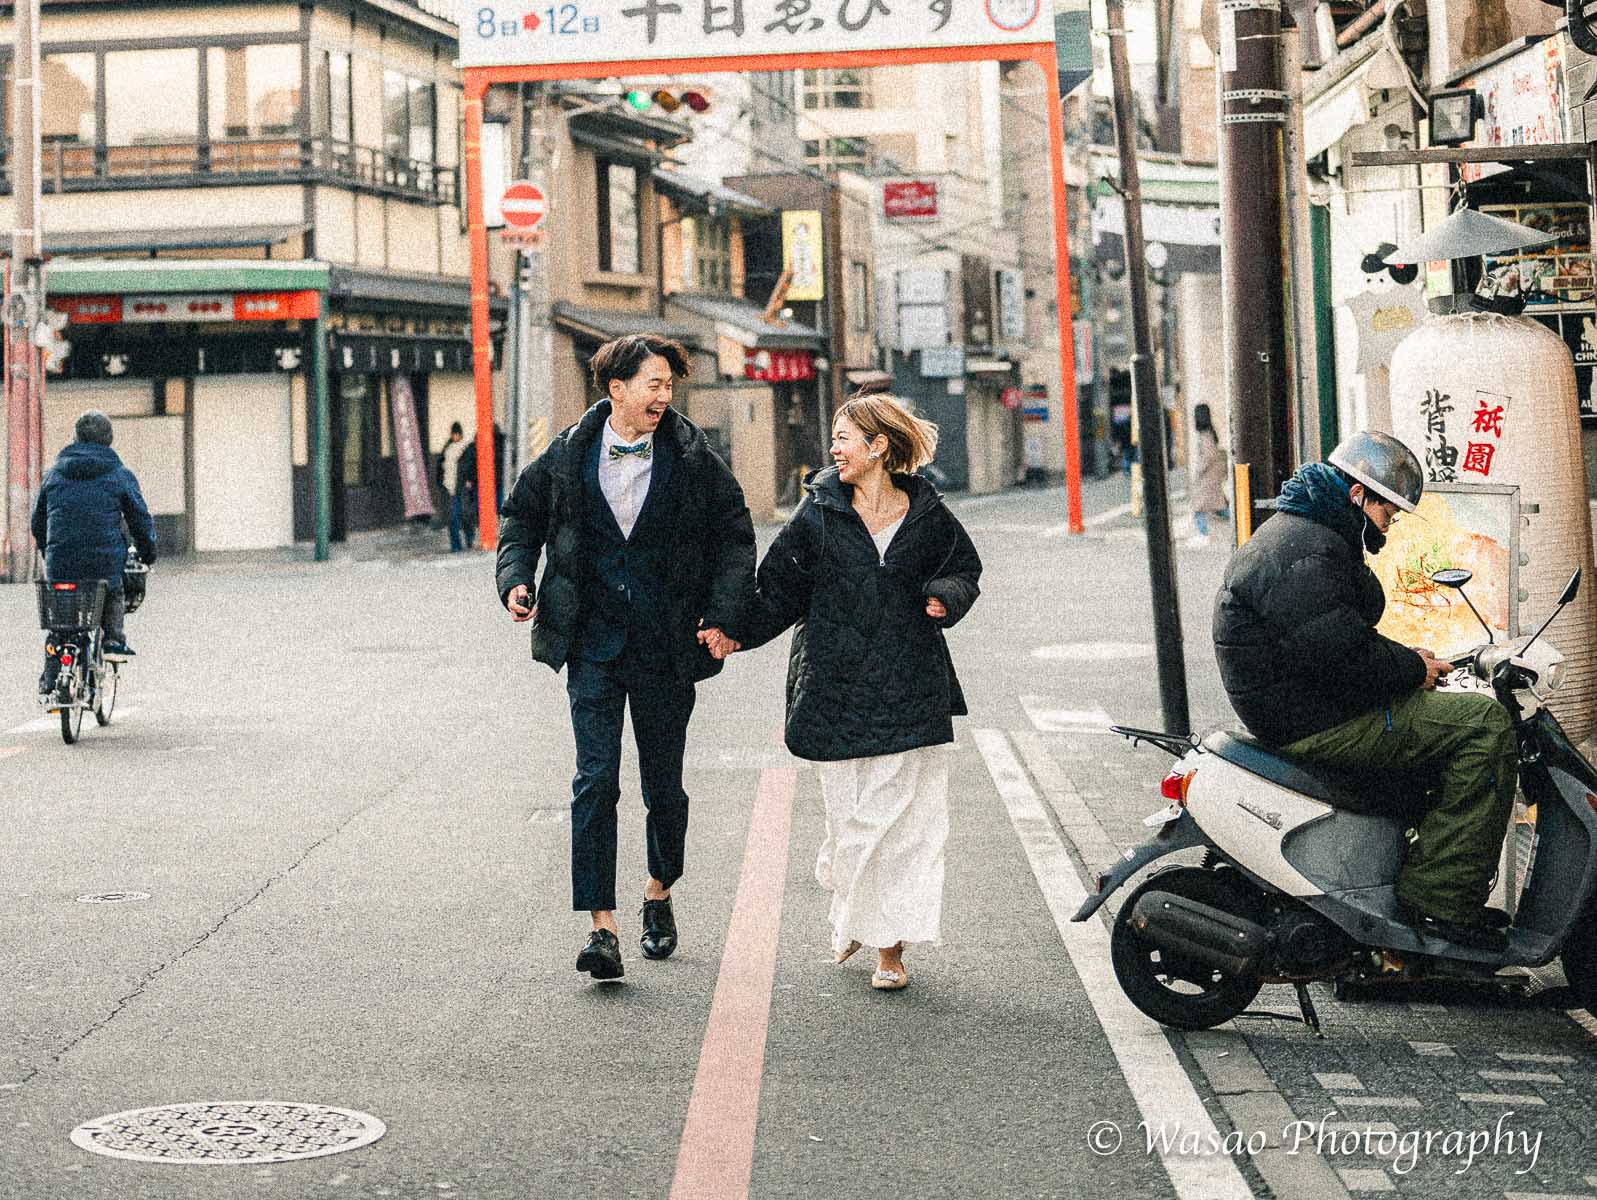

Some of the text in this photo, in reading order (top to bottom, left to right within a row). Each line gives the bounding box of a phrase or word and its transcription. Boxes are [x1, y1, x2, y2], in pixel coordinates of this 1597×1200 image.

[476, 8, 518, 38] 8日
[545, 3, 601, 35] 12日
[1462, 399, 1504, 477] 祇園
